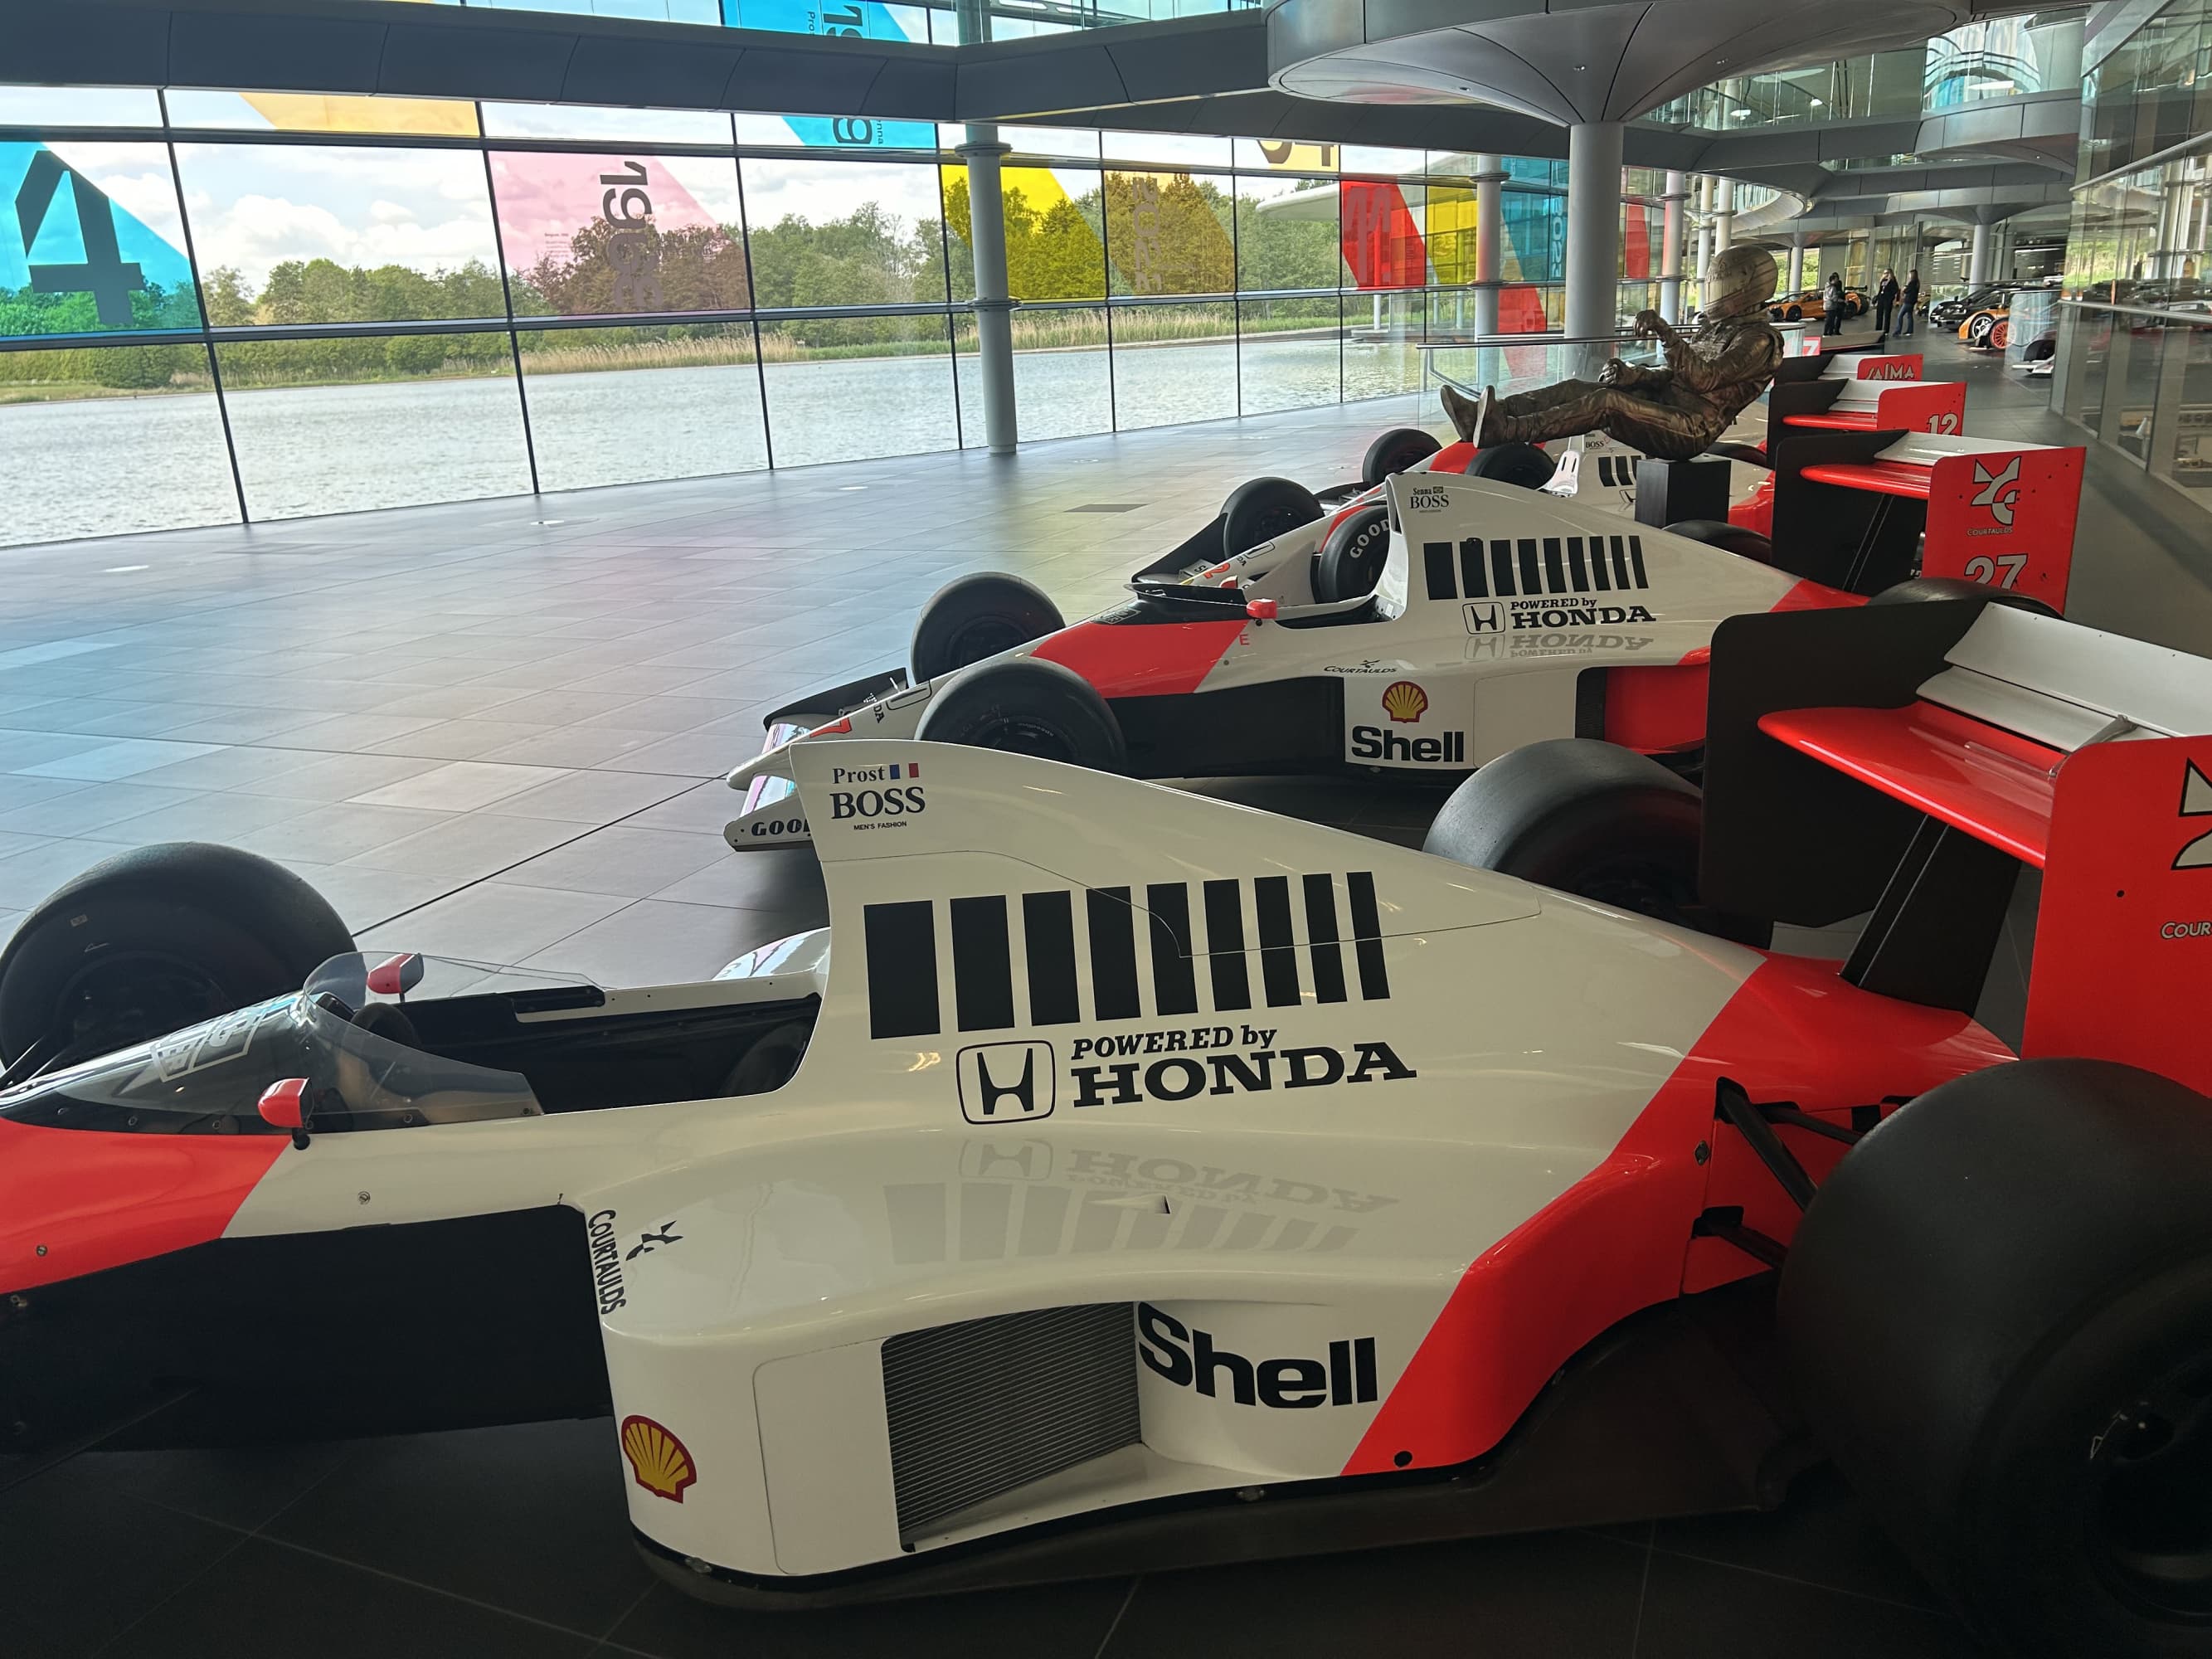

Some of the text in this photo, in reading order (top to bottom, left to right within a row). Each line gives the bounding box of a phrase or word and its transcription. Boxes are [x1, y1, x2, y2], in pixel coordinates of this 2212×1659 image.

[807, 11, 816, 34] Pro
[1926, 411, 1958, 435] 12
[1409, 494, 1450, 508] BOSS
[1412, 487, 1432, 495] Senna
[1966, 527, 2013, 537] COURTAULDS
[1964, 552, 2029, 591] 27
[1510, 597, 1597, 611] POWERED by
[1510, 606, 1657, 630] HONDA
[1239, 634, 1250, 645] E
[1324, 665, 1397, 674] COURTAULDS
[1351, 725, 1465, 762] Shell
[832, 766, 886, 785] Prost
[829, 786, 926, 820] BOSS
[878, 820, 907, 830] FASHION
[1071, 1024, 1277, 1061] POWERED by
[1070, 1041, 1417, 1108] HONDA
[588, 1209, 627, 1315] COURTAULDS
[1137, 1301, 1378, 1409] Shell
